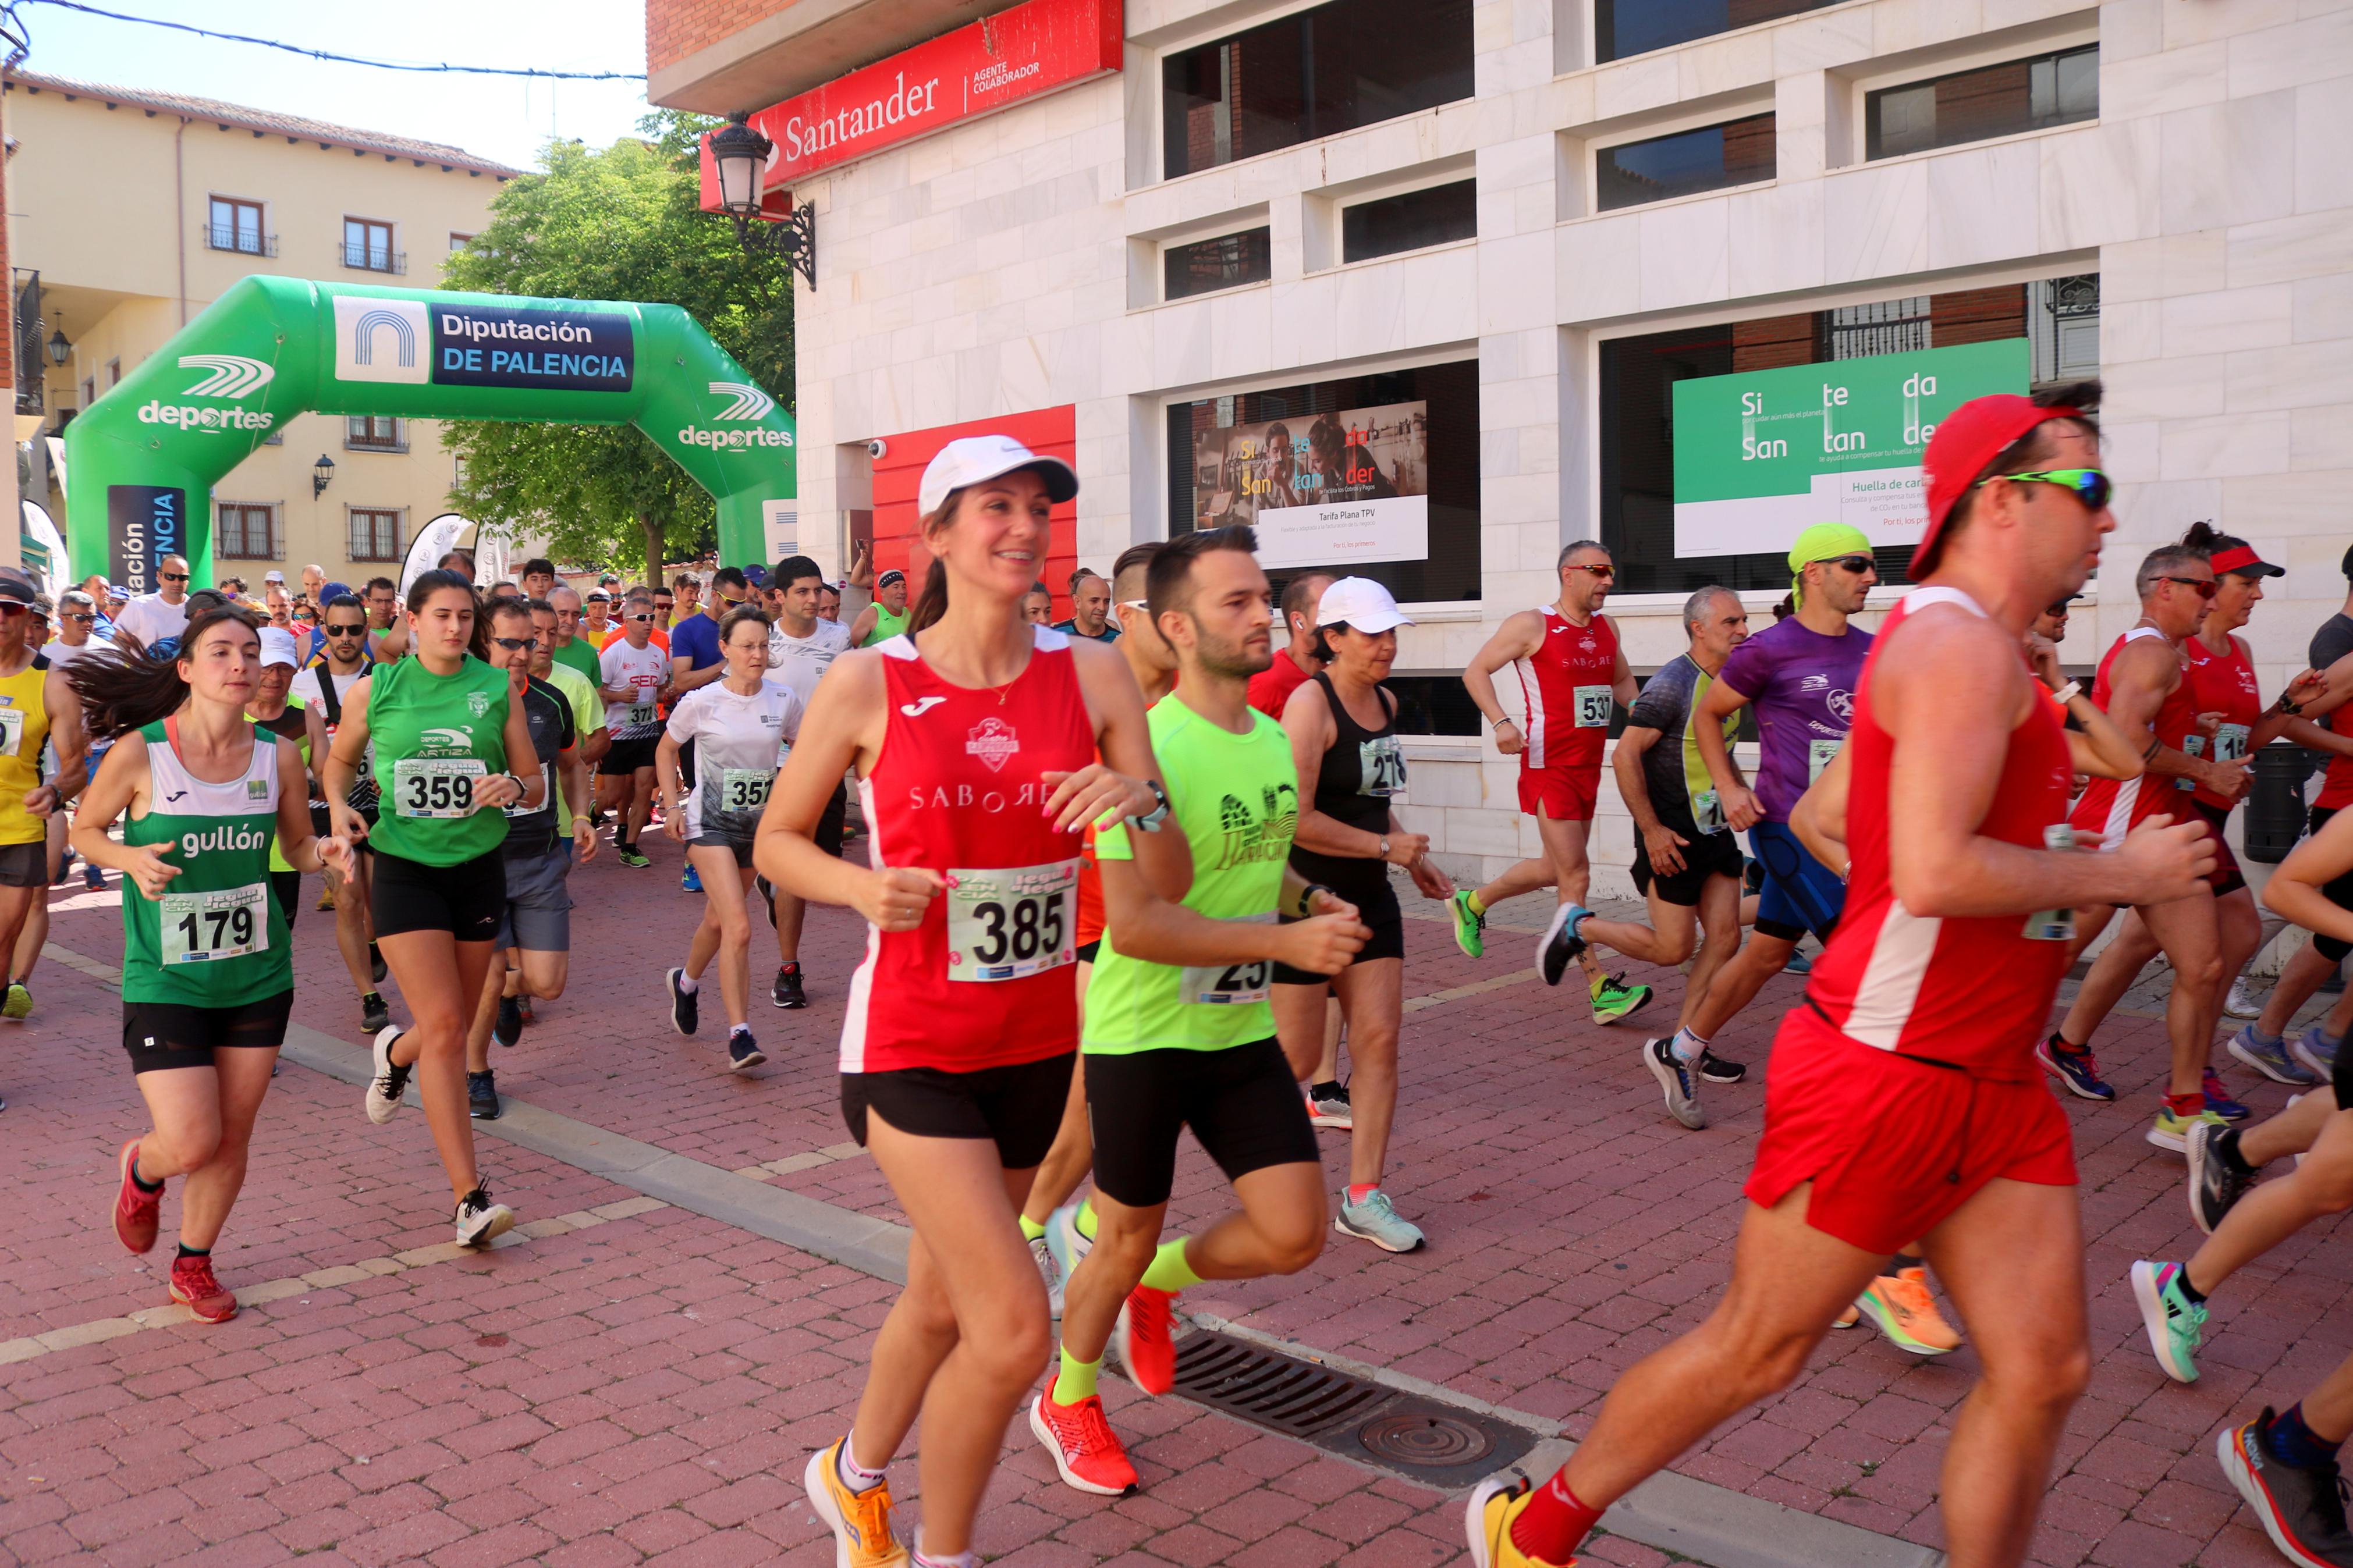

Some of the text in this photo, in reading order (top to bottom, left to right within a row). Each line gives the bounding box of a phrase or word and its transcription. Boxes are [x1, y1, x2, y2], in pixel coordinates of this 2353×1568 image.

[974, 61, 1007, 83] AGENTE
[974, 62, 1039, 94] COLABORADOR
[786, 70, 938, 162] Santander
[442, 314, 592, 342] Diputación
[443, 348, 626, 378] DE PALENCIA
[1742, 372, 1936, 416] Si te da
[138, 400, 274, 430] deportes
[1802, 410, 1825, 418] planeta
[679, 425, 793, 451] deportes
[1241, 426, 1368, 460] Si te da
[1742, 437, 1787, 460] San
[1824, 430, 1865, 453] tan
[1826, 454, 1844, 463] ayuda
[1850, 450, 1883, 460] compensar
[1241, 464, 1375, 496] San tan der
[1852, 481, 1886, 492] Huella
[1889, 479, 1902, 489] de
[1841, 496, 1868, 504] Consulta
[1873, 493, 1905, 502] compensa
[1319, 509, 1376, 521] Tarifa Plana TPV
[1905, 516, 1915, 524] los
[1355, 540, 1376, 548] primeros
[1562, 656, 1614, 669] SABORE
[630, 675, 658, 687] SER
[1584, 696, 1610, 721] 537
[417, 748, 472, 758] ARTIZA
[408, 776, 473, 809] 359
[182, 824, 264, 858] gullón
[179, 906, 252, 951] 179
[973, 893, 1064, 964] 385
